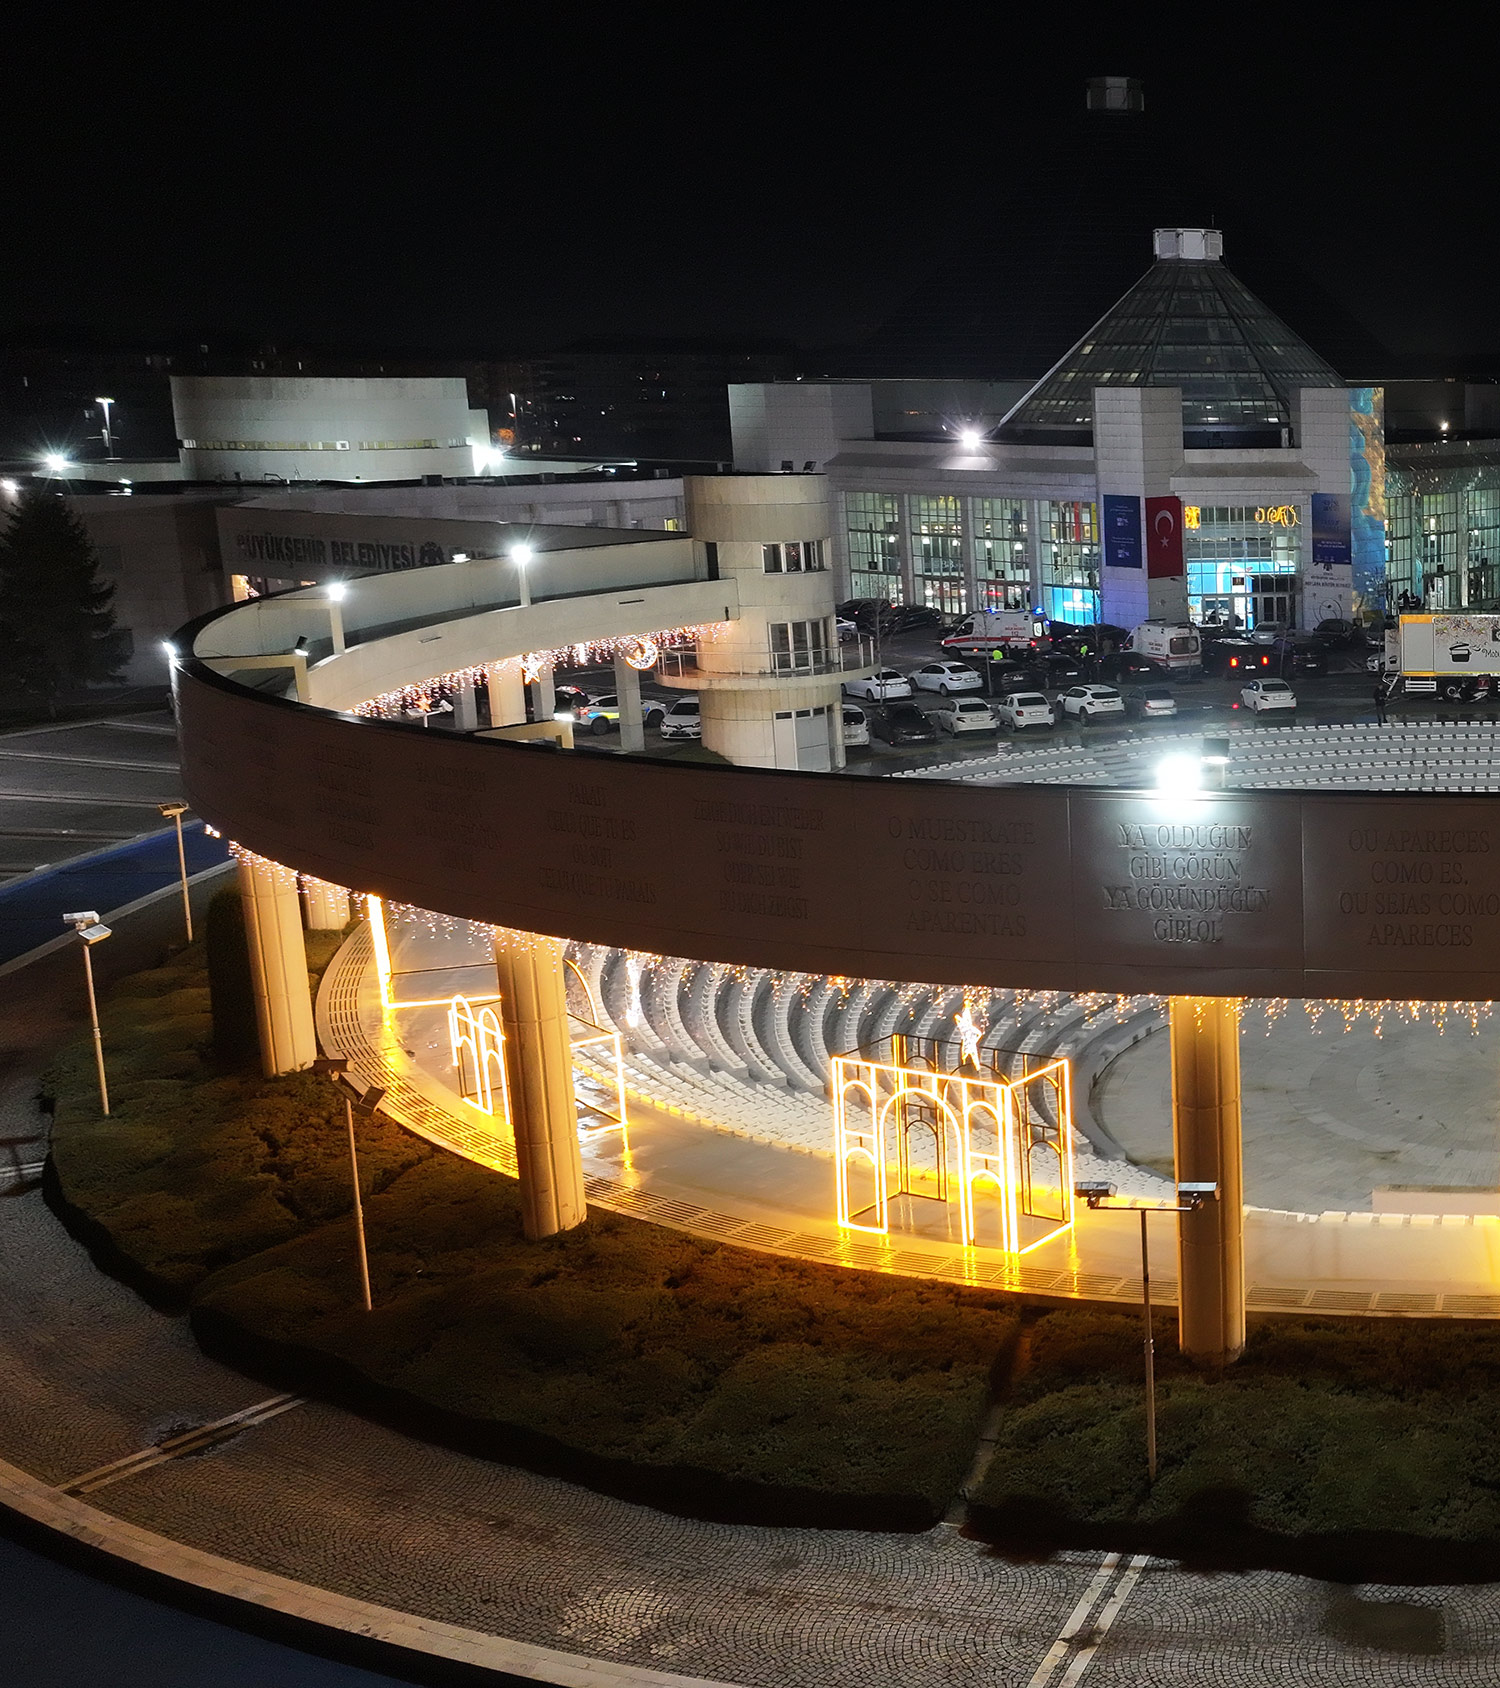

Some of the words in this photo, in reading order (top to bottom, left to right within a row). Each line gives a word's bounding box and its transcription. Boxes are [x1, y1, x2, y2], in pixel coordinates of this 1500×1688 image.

[332, 537, 415, 569] BELEDİYESİ
[620, 819, 636, 841] ES
[888, 816, 902, 838] O
[908, 817, 1036, 845] MUESTRATE
[1118, 824, 1148, 847] YA
[1156, 823, 1251, 849] OLDUĞUN
[1349, 829, 1379, 853] OU
[1384, 830, 1491, 853] APARECES
[903, 848, 965, 873] COMO
[970, 851, 1024, 875] ERES
[1130, 852, 1168, 880] GİBİ
[1173, 852, 1241, 881] GÖRÜN
[1371, 861, 1434, 884] COMO
[1440, 862, 1469, 886] ES,
[908, 879, 922, 901] O
[928, 879, 952, 903] SE
[957, 881, 1021, 906] COMO
[1103, 886, 1132, 910] YA
[1137, 882, 1271, 913] GÖRÜNDÜĞÜN
[1340, 892, 1369, 915] OU
[1375, 893, 1432, 915] SEJAS
[1438, 893, 1500, 916] COMO
[905, 909, 1027, 937] APARENTAS
[1154, 914, 1193, 942] GİBİ
[1196, 919, 1223, 942] OL
[1367, 924, 1474, 947] APARECES
